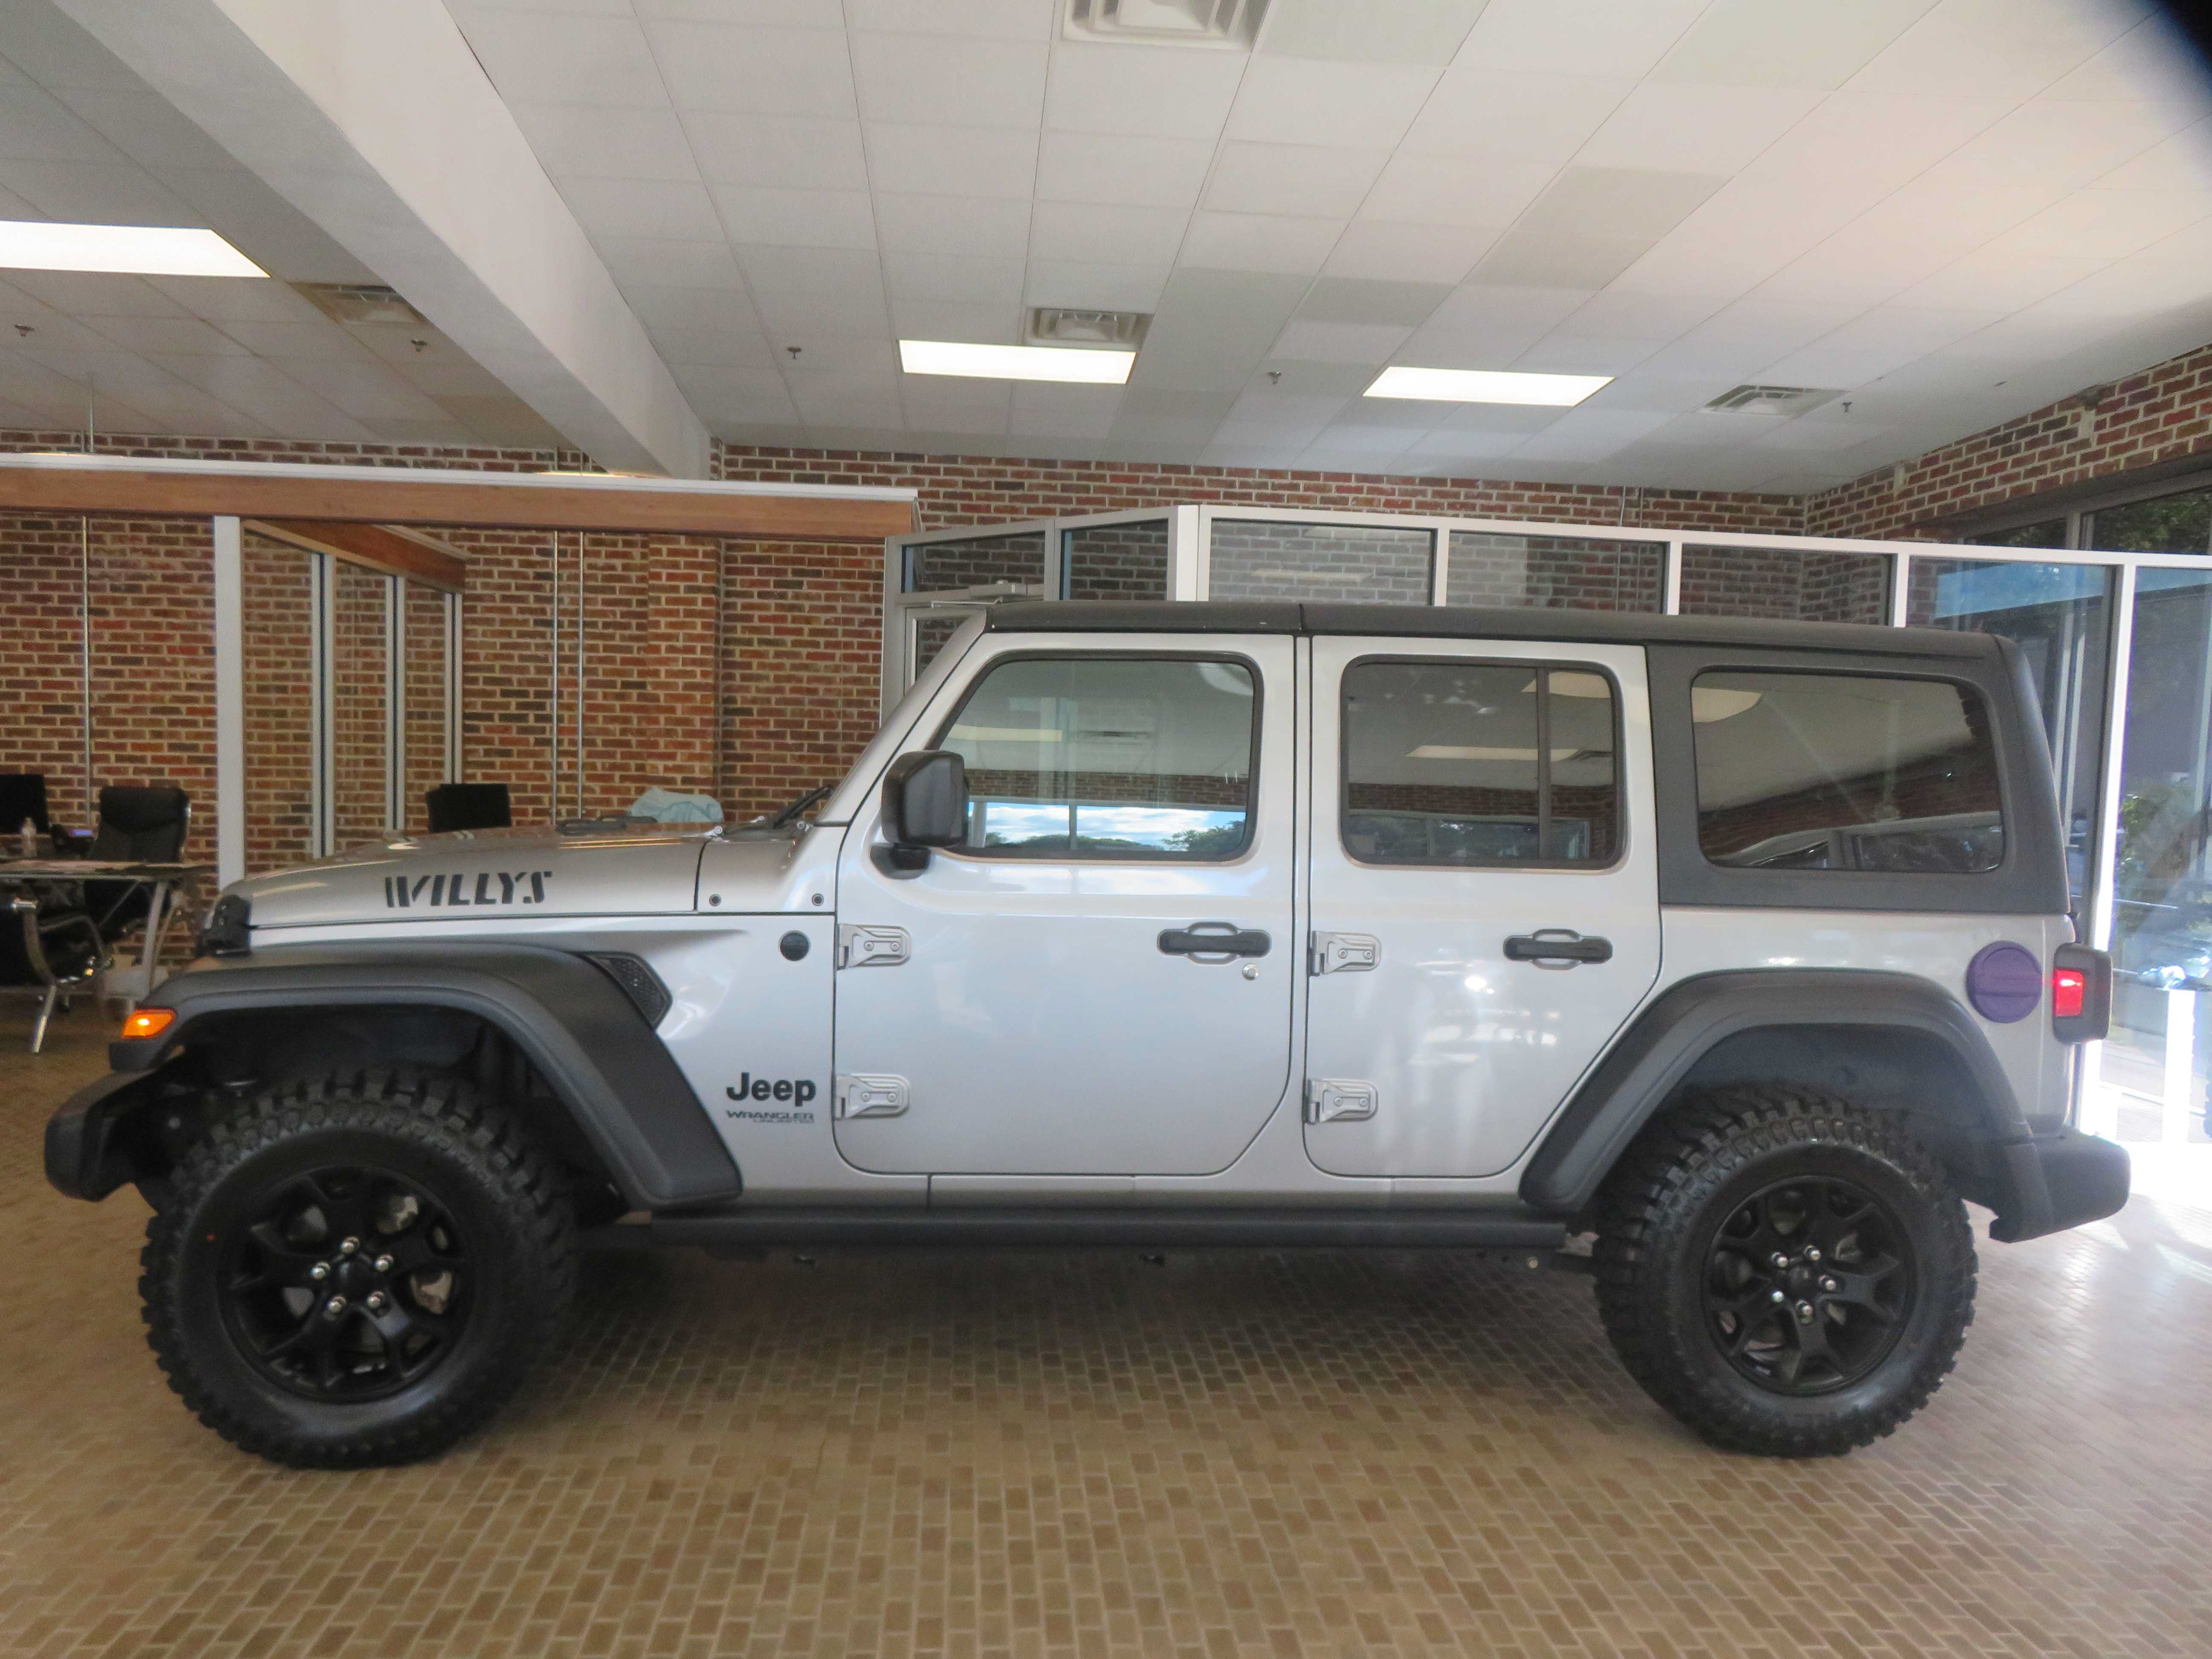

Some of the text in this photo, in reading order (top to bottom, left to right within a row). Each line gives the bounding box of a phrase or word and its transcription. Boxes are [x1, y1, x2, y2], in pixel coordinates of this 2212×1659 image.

[385, 871, 553, 908] WILLYS
[726, 1072, 816, 1107] Jeep
[726, 1110, 814, 1119] WRANGLER
